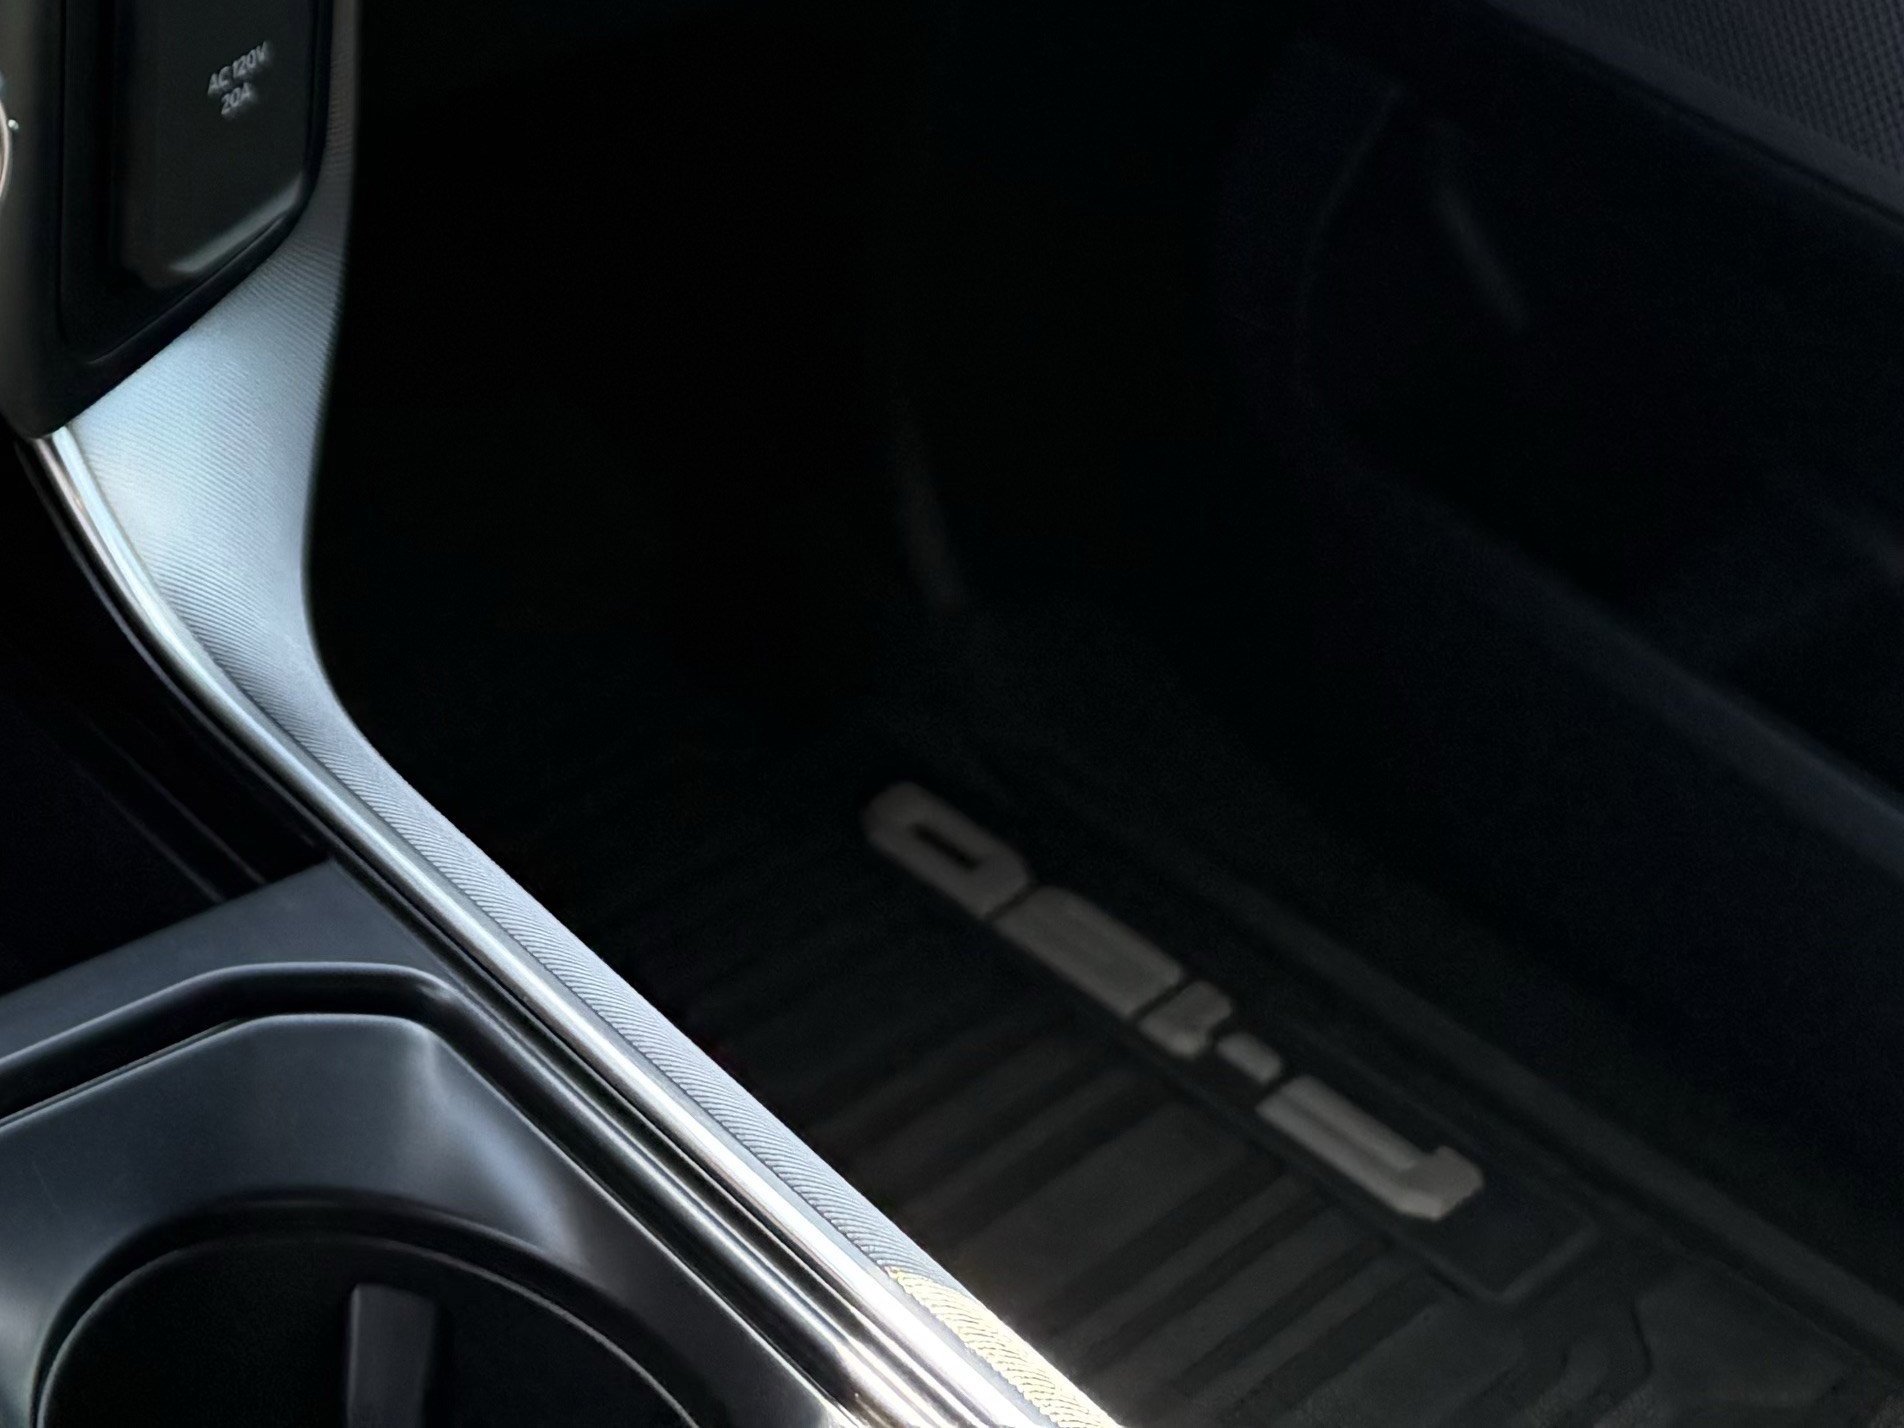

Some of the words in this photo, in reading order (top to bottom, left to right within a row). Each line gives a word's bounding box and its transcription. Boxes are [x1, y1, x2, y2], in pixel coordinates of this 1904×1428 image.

[207, 65, 231, 96] AC
[231, 40, 268, 80] 120V
[220, 81, 251, 116] 20A
